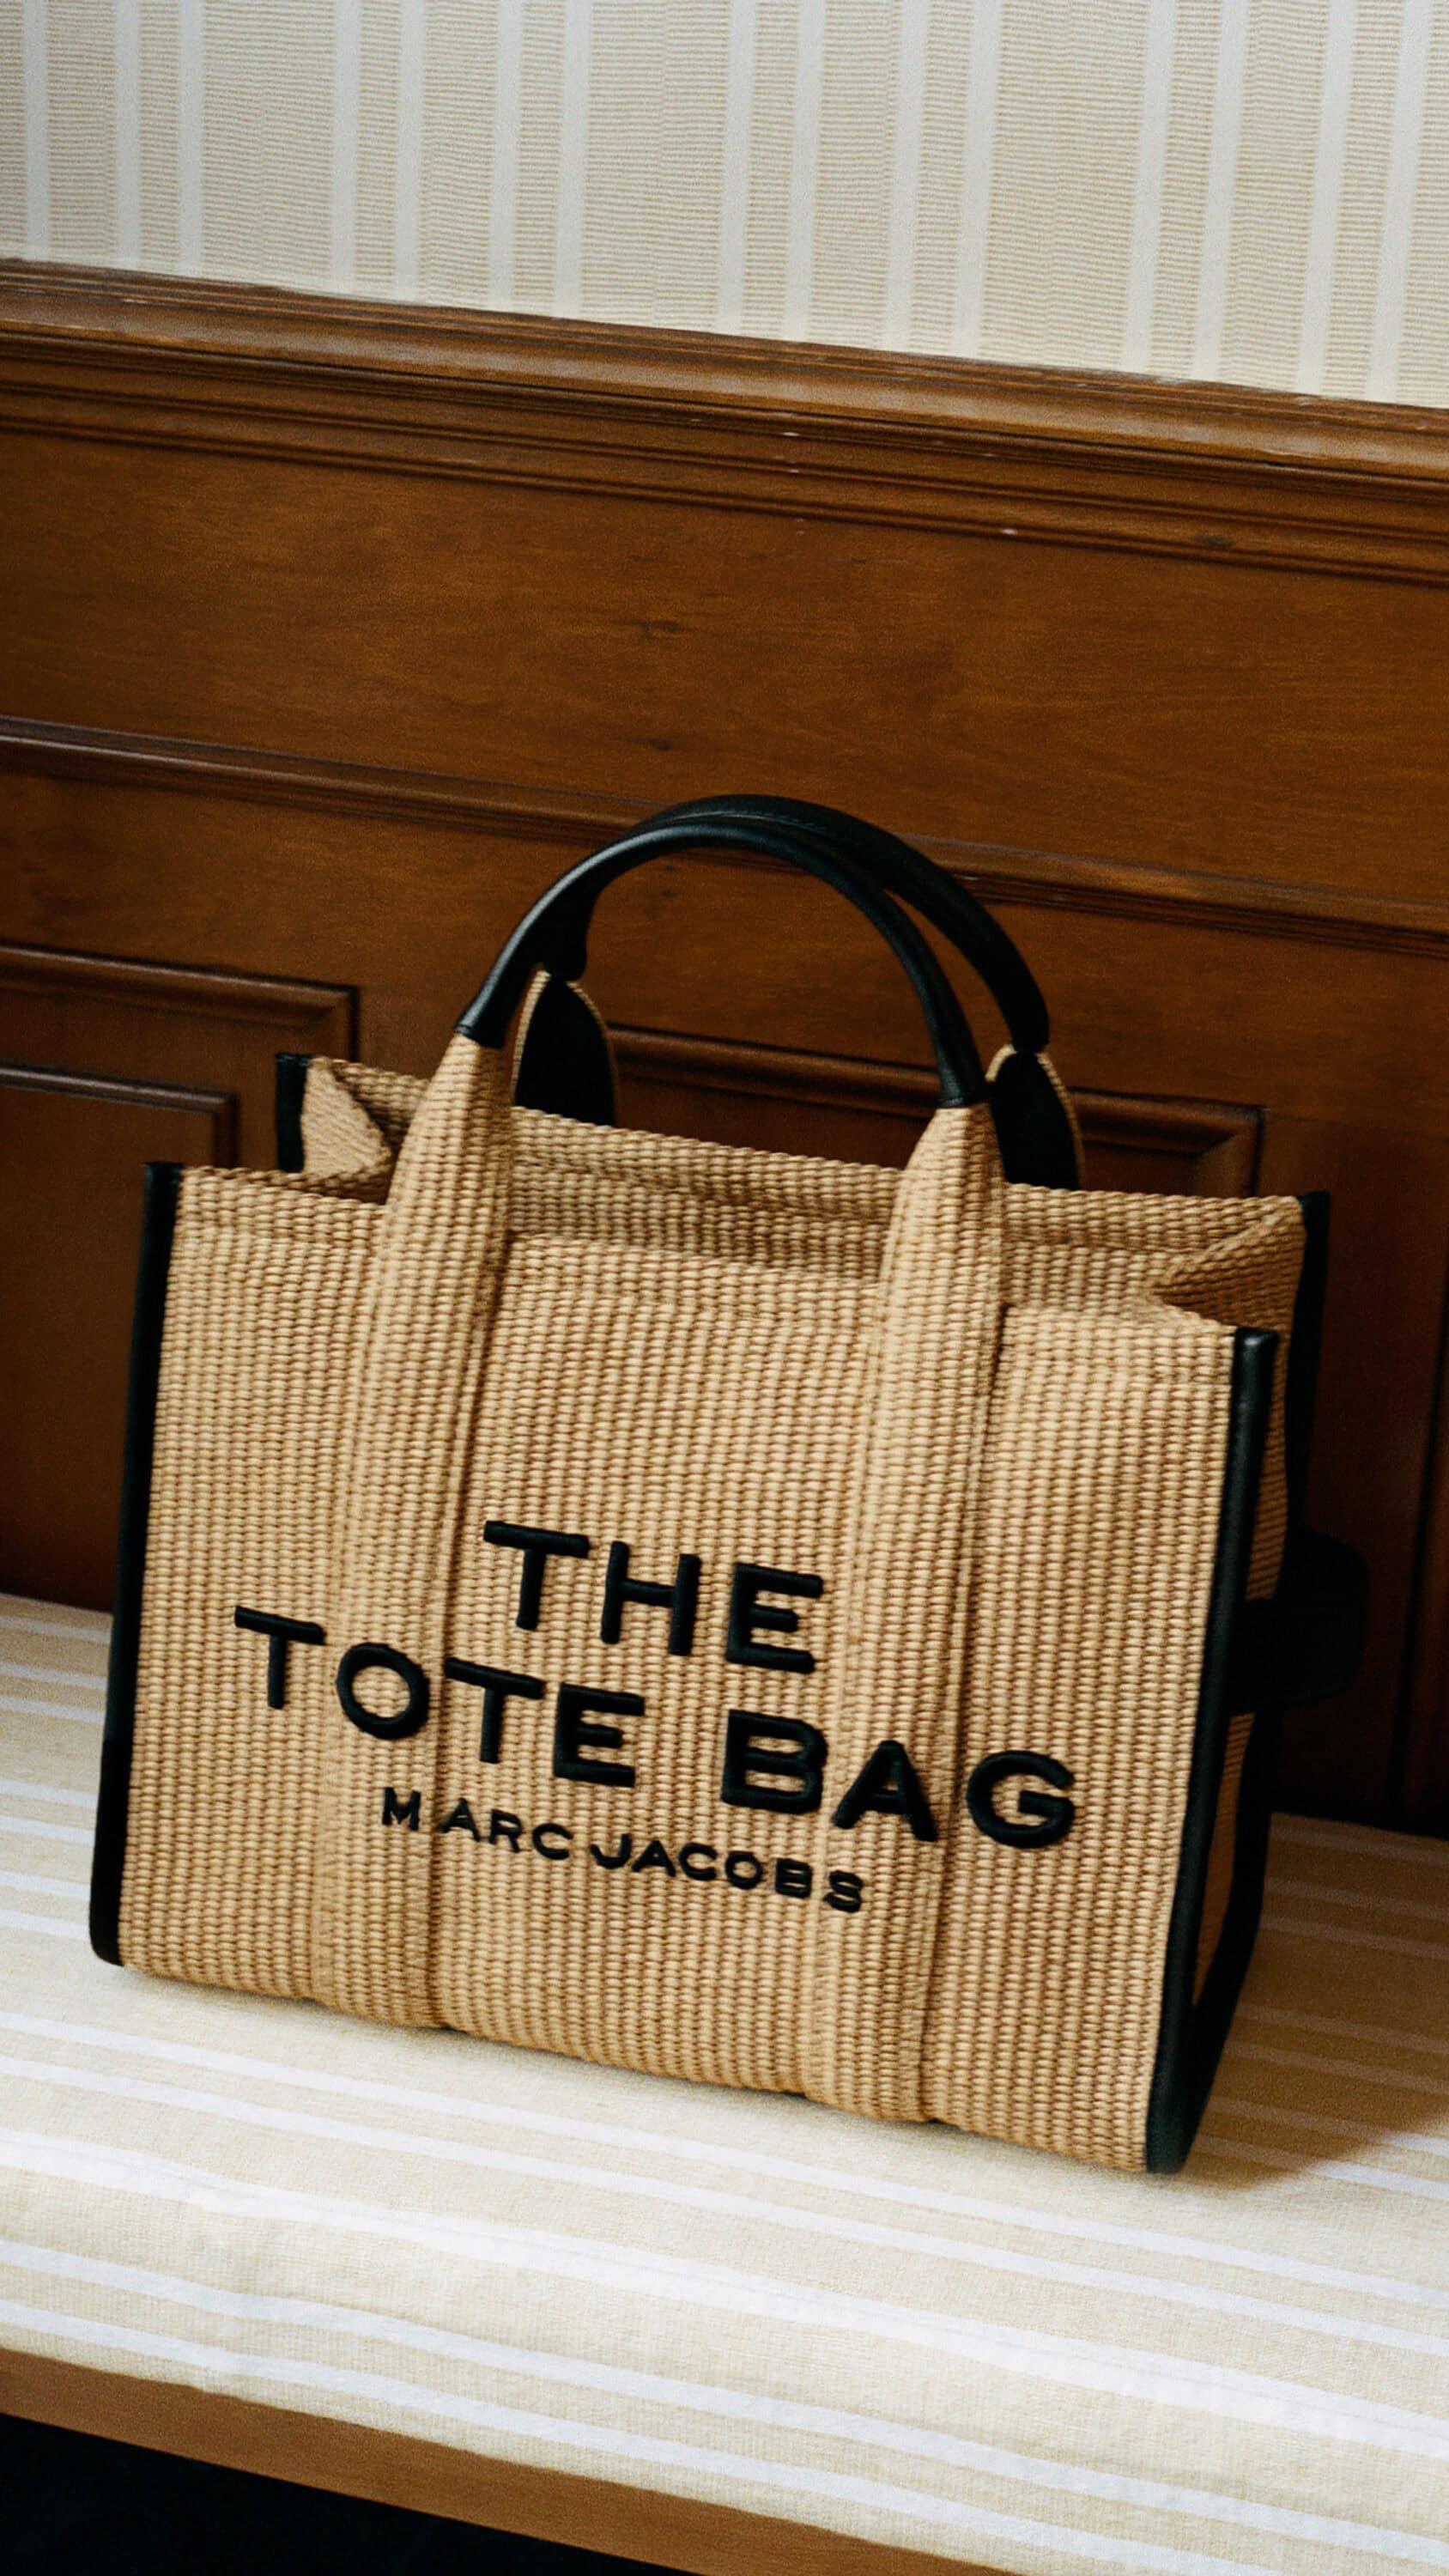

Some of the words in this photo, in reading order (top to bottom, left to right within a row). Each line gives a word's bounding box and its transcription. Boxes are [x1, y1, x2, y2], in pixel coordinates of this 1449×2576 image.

[483, 1520, 825, 1674] THE
[234, 1605, 646, 1788] TOTE
[720, 1709, 1079, 1850] BAG
[381, 1787, 573, 1861] MARC
[589, 1833, 864, 1913] JACOBS
